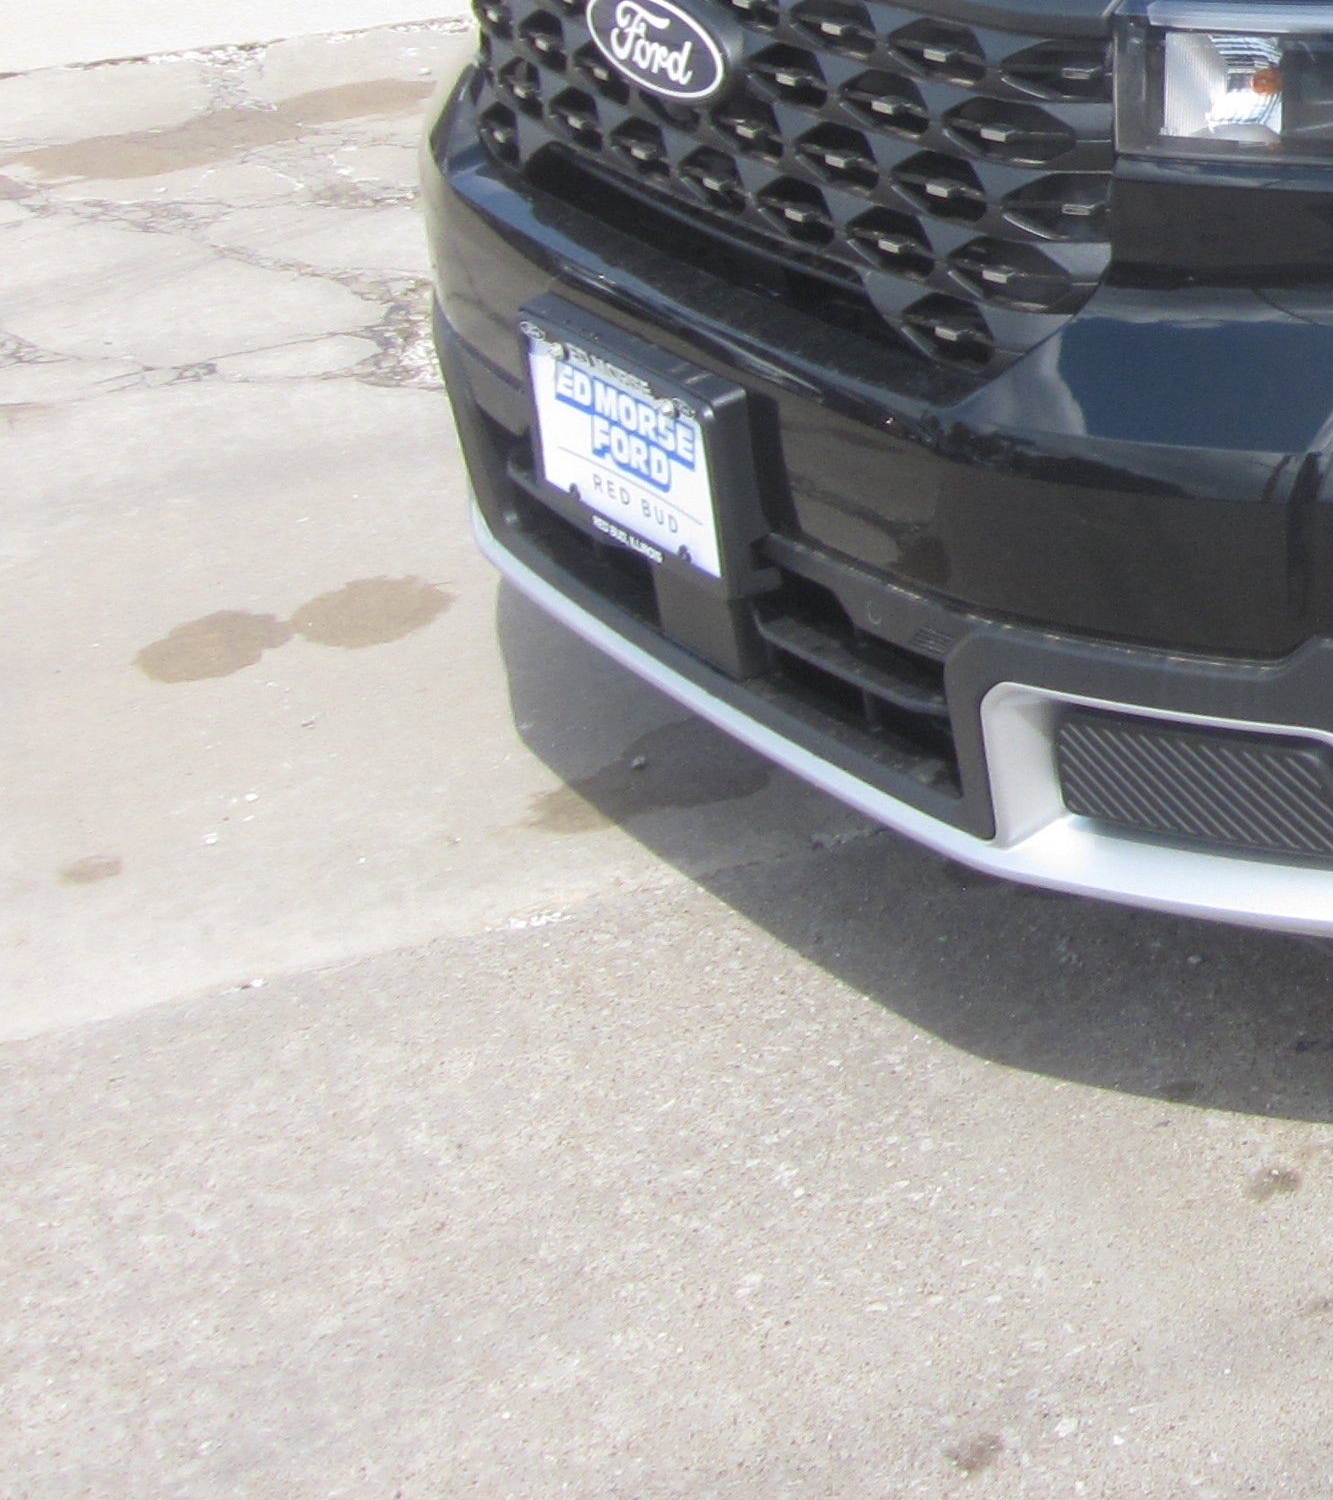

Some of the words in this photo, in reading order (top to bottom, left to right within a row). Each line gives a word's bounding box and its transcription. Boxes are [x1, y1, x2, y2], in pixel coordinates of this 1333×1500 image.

[610, 0, 694, 85] Ford
[556, 363, 592, 407] ED
[593, 379, 696, 464] MORSE
[593, 419, 669, 487] FORD
[593, 473, 631, 506] RED
[641, 498, 679, 534] BUD
